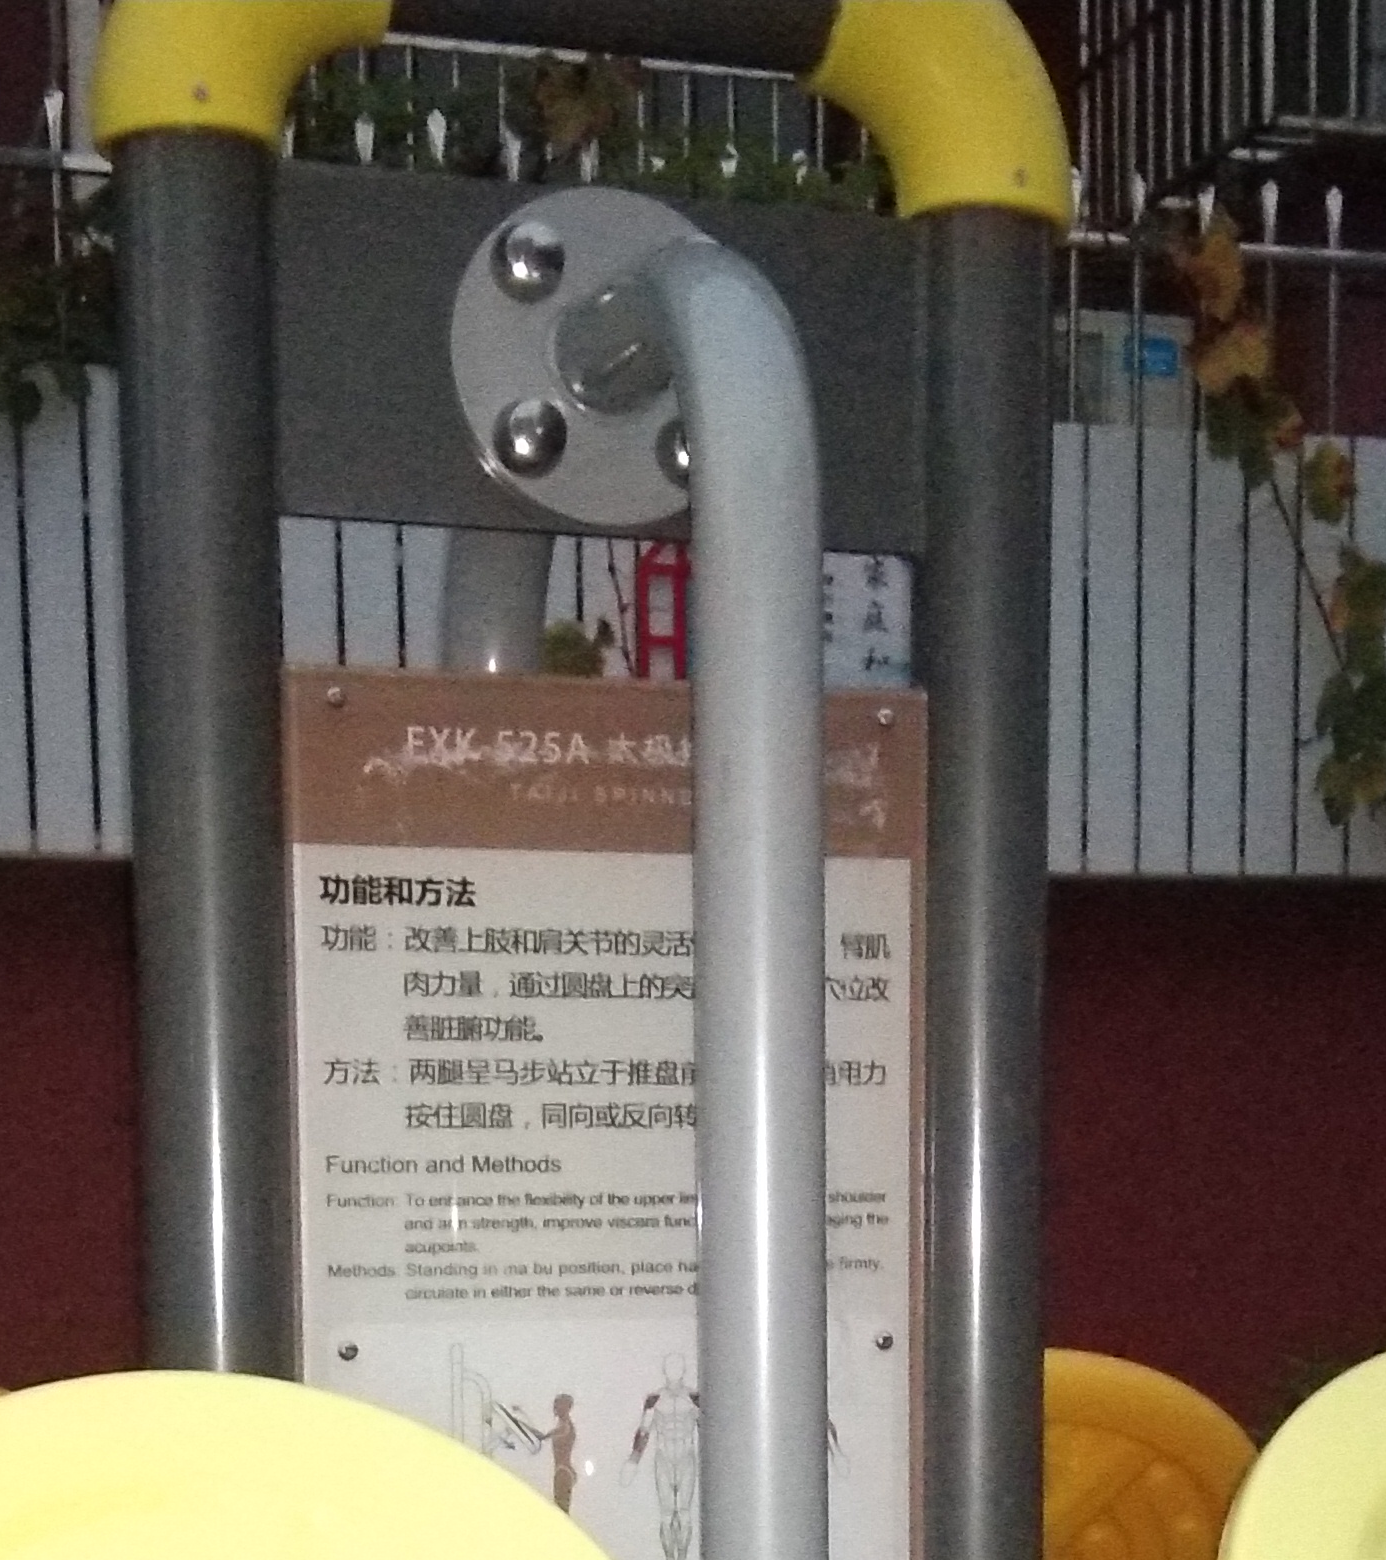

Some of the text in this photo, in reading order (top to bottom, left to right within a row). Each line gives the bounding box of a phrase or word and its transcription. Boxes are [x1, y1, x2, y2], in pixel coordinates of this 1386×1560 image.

[319, 874, 477, 908] 功能和方法
[326, 1155, 562, 1174] Function and Methods
[406, 1193, 424, 1207] To
[497, 1193, 520, 1206] the
[589, 1193, 603, 1206] of
[607, 1193, 630, 1205] the
[634, 1194, 675, 1208] upper
[404, 1217, 433, 1230] and
[543, 1217, 602, 1231] improve
[406, 1262, 478, 1279] Standing
[483, 1264, 498, 1276] in
[533, 1262, 553, 1275] bu
[631, 1261, 673, 1276] place
[474, 1287, 486, 1298] in
[491, 1285, 531, 1298] either
[537, 1285, 560, 1297] the
[565, 1286, 605, 1297] same
[609, 1286, 623, 1296] or
[629, 1284, 685, 1296] reverse
